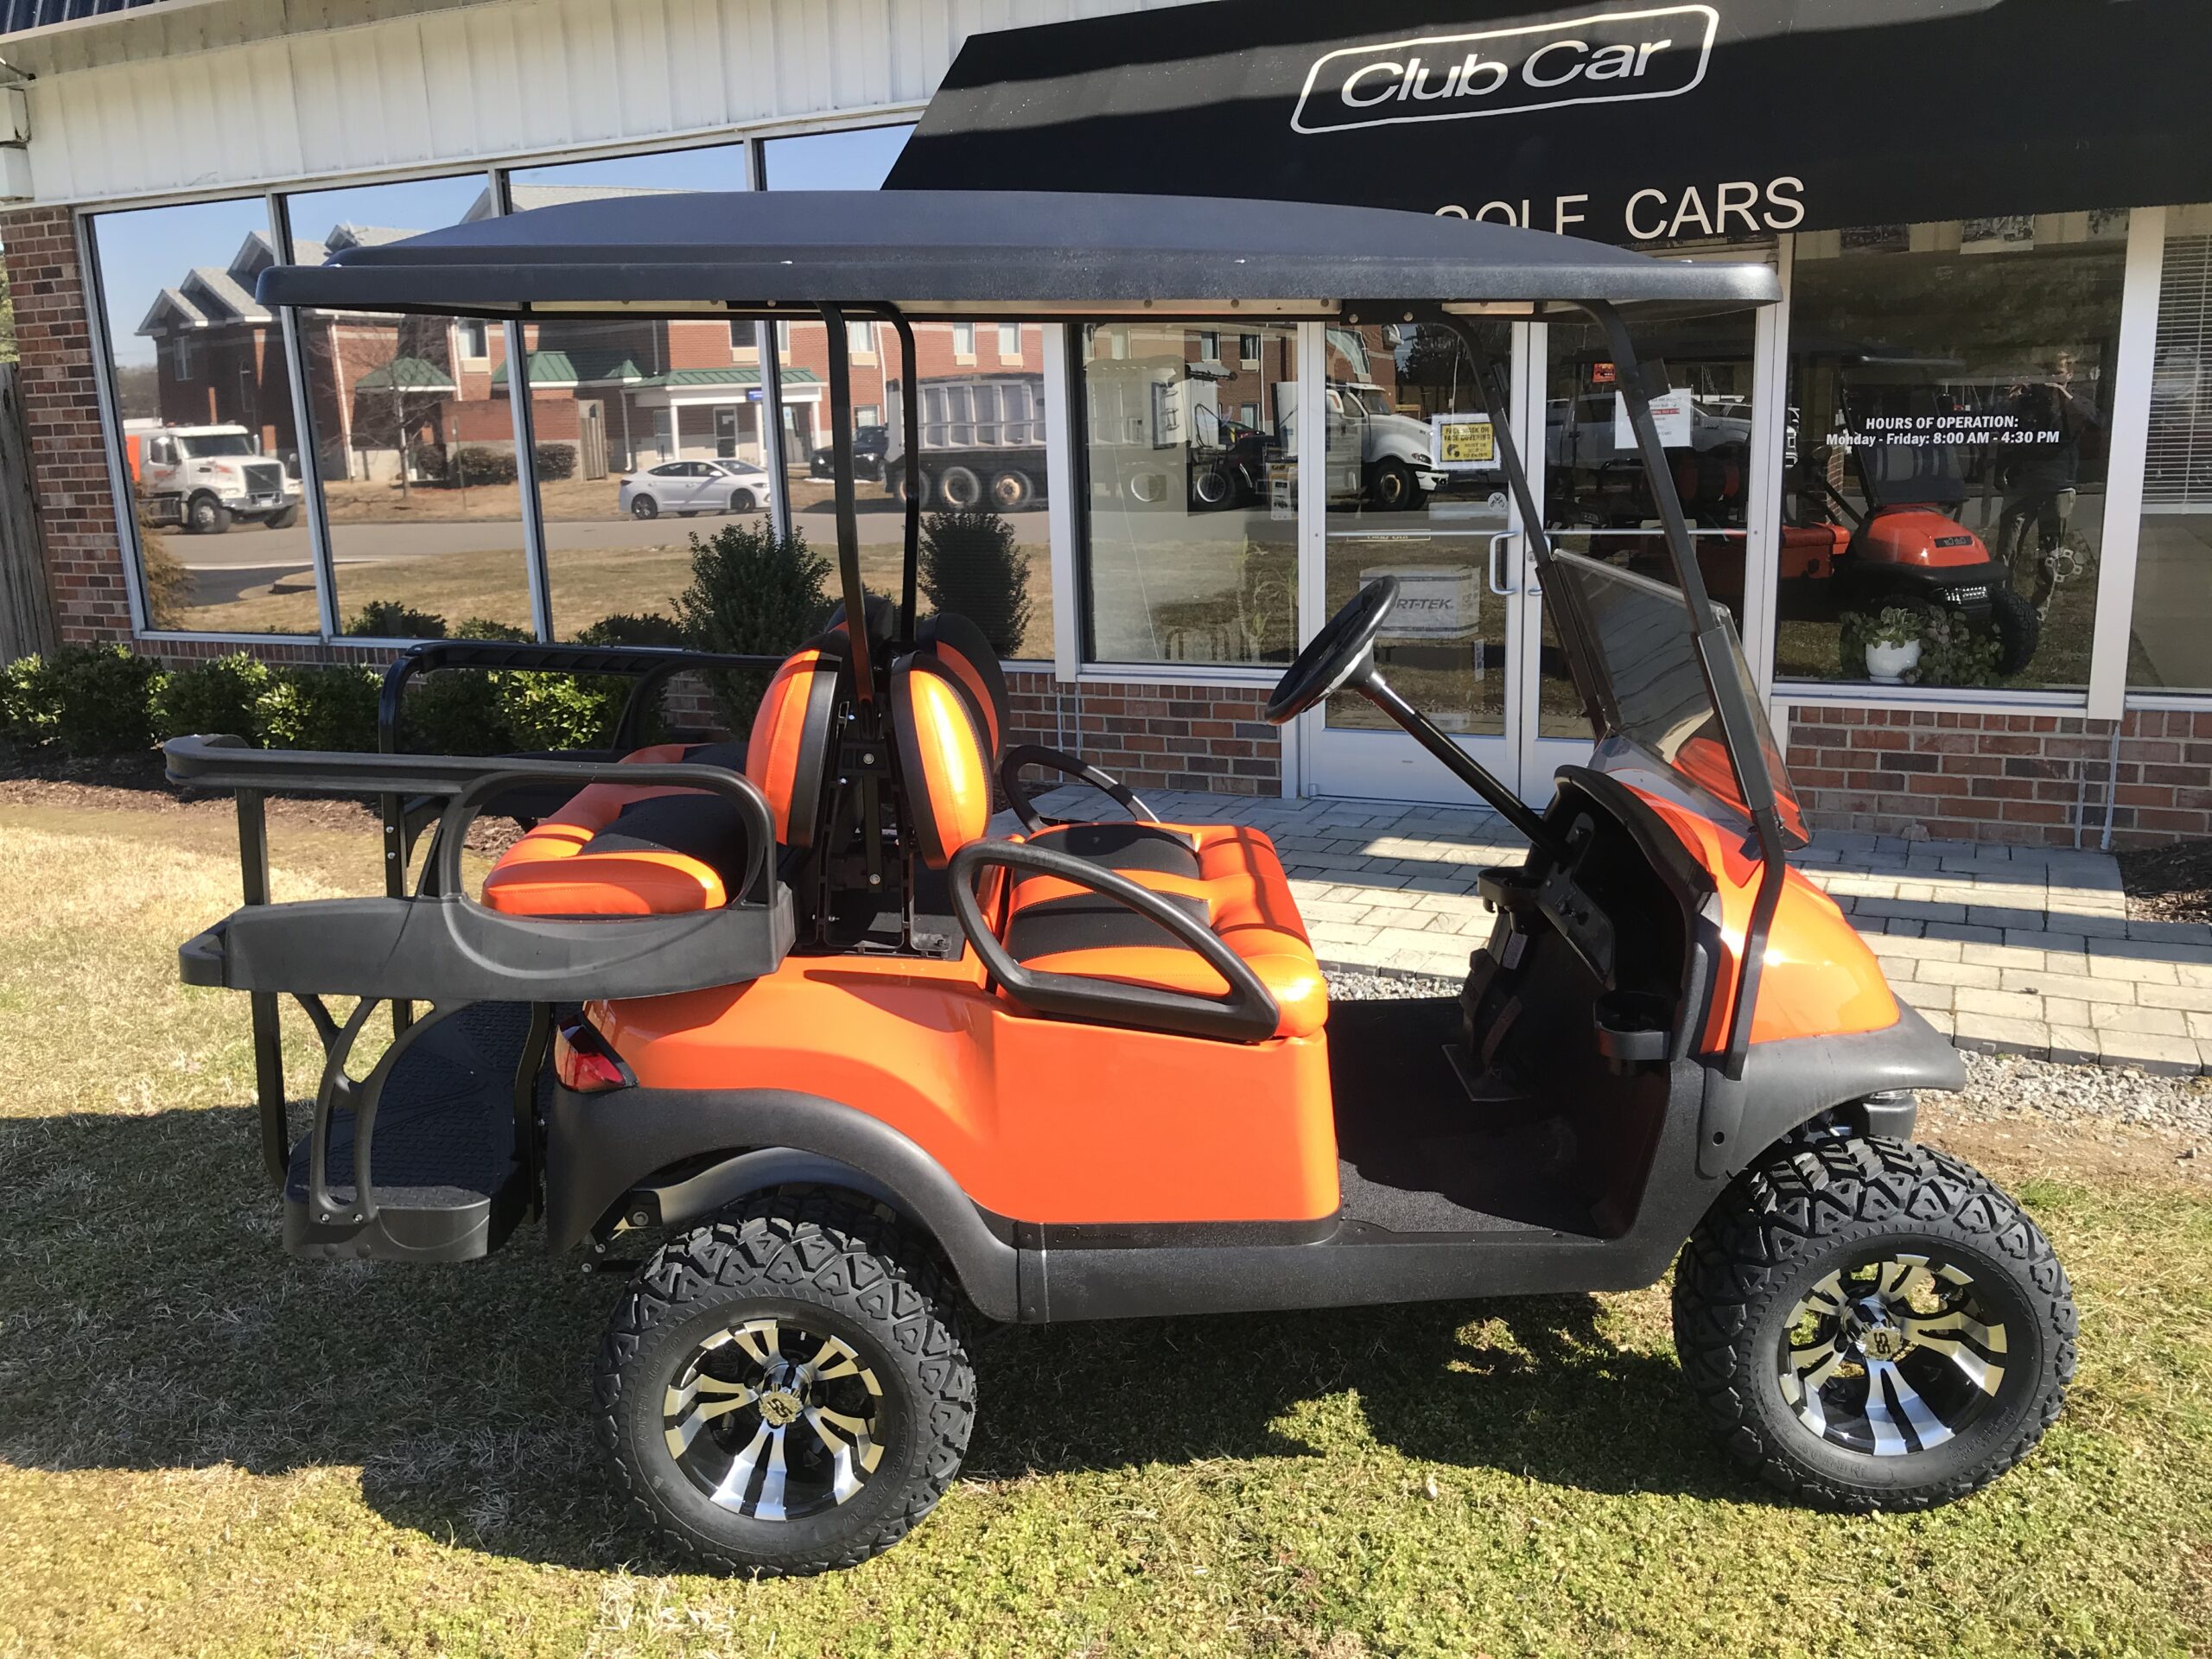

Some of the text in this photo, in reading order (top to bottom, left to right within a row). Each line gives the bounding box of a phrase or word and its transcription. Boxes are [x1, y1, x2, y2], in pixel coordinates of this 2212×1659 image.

[1340, 39, 1673, 109] Club Car
[1624, 176, 1806, 240] CARS
[1866, 415, 2019, 430] HOURS OF OPERATION:
[1826, 433, 1877, 448] Monday
[1886, 433, 1930, 448] Friday:
[1933, 432, 1965, 445] 8:00
[1966, 431, 1990, 444] AM
[2001, 431, 2034, 444] 4:30
[2037, 430, 2060, 443] PM
[1395, 598, 1452, 609] RT-TEK
